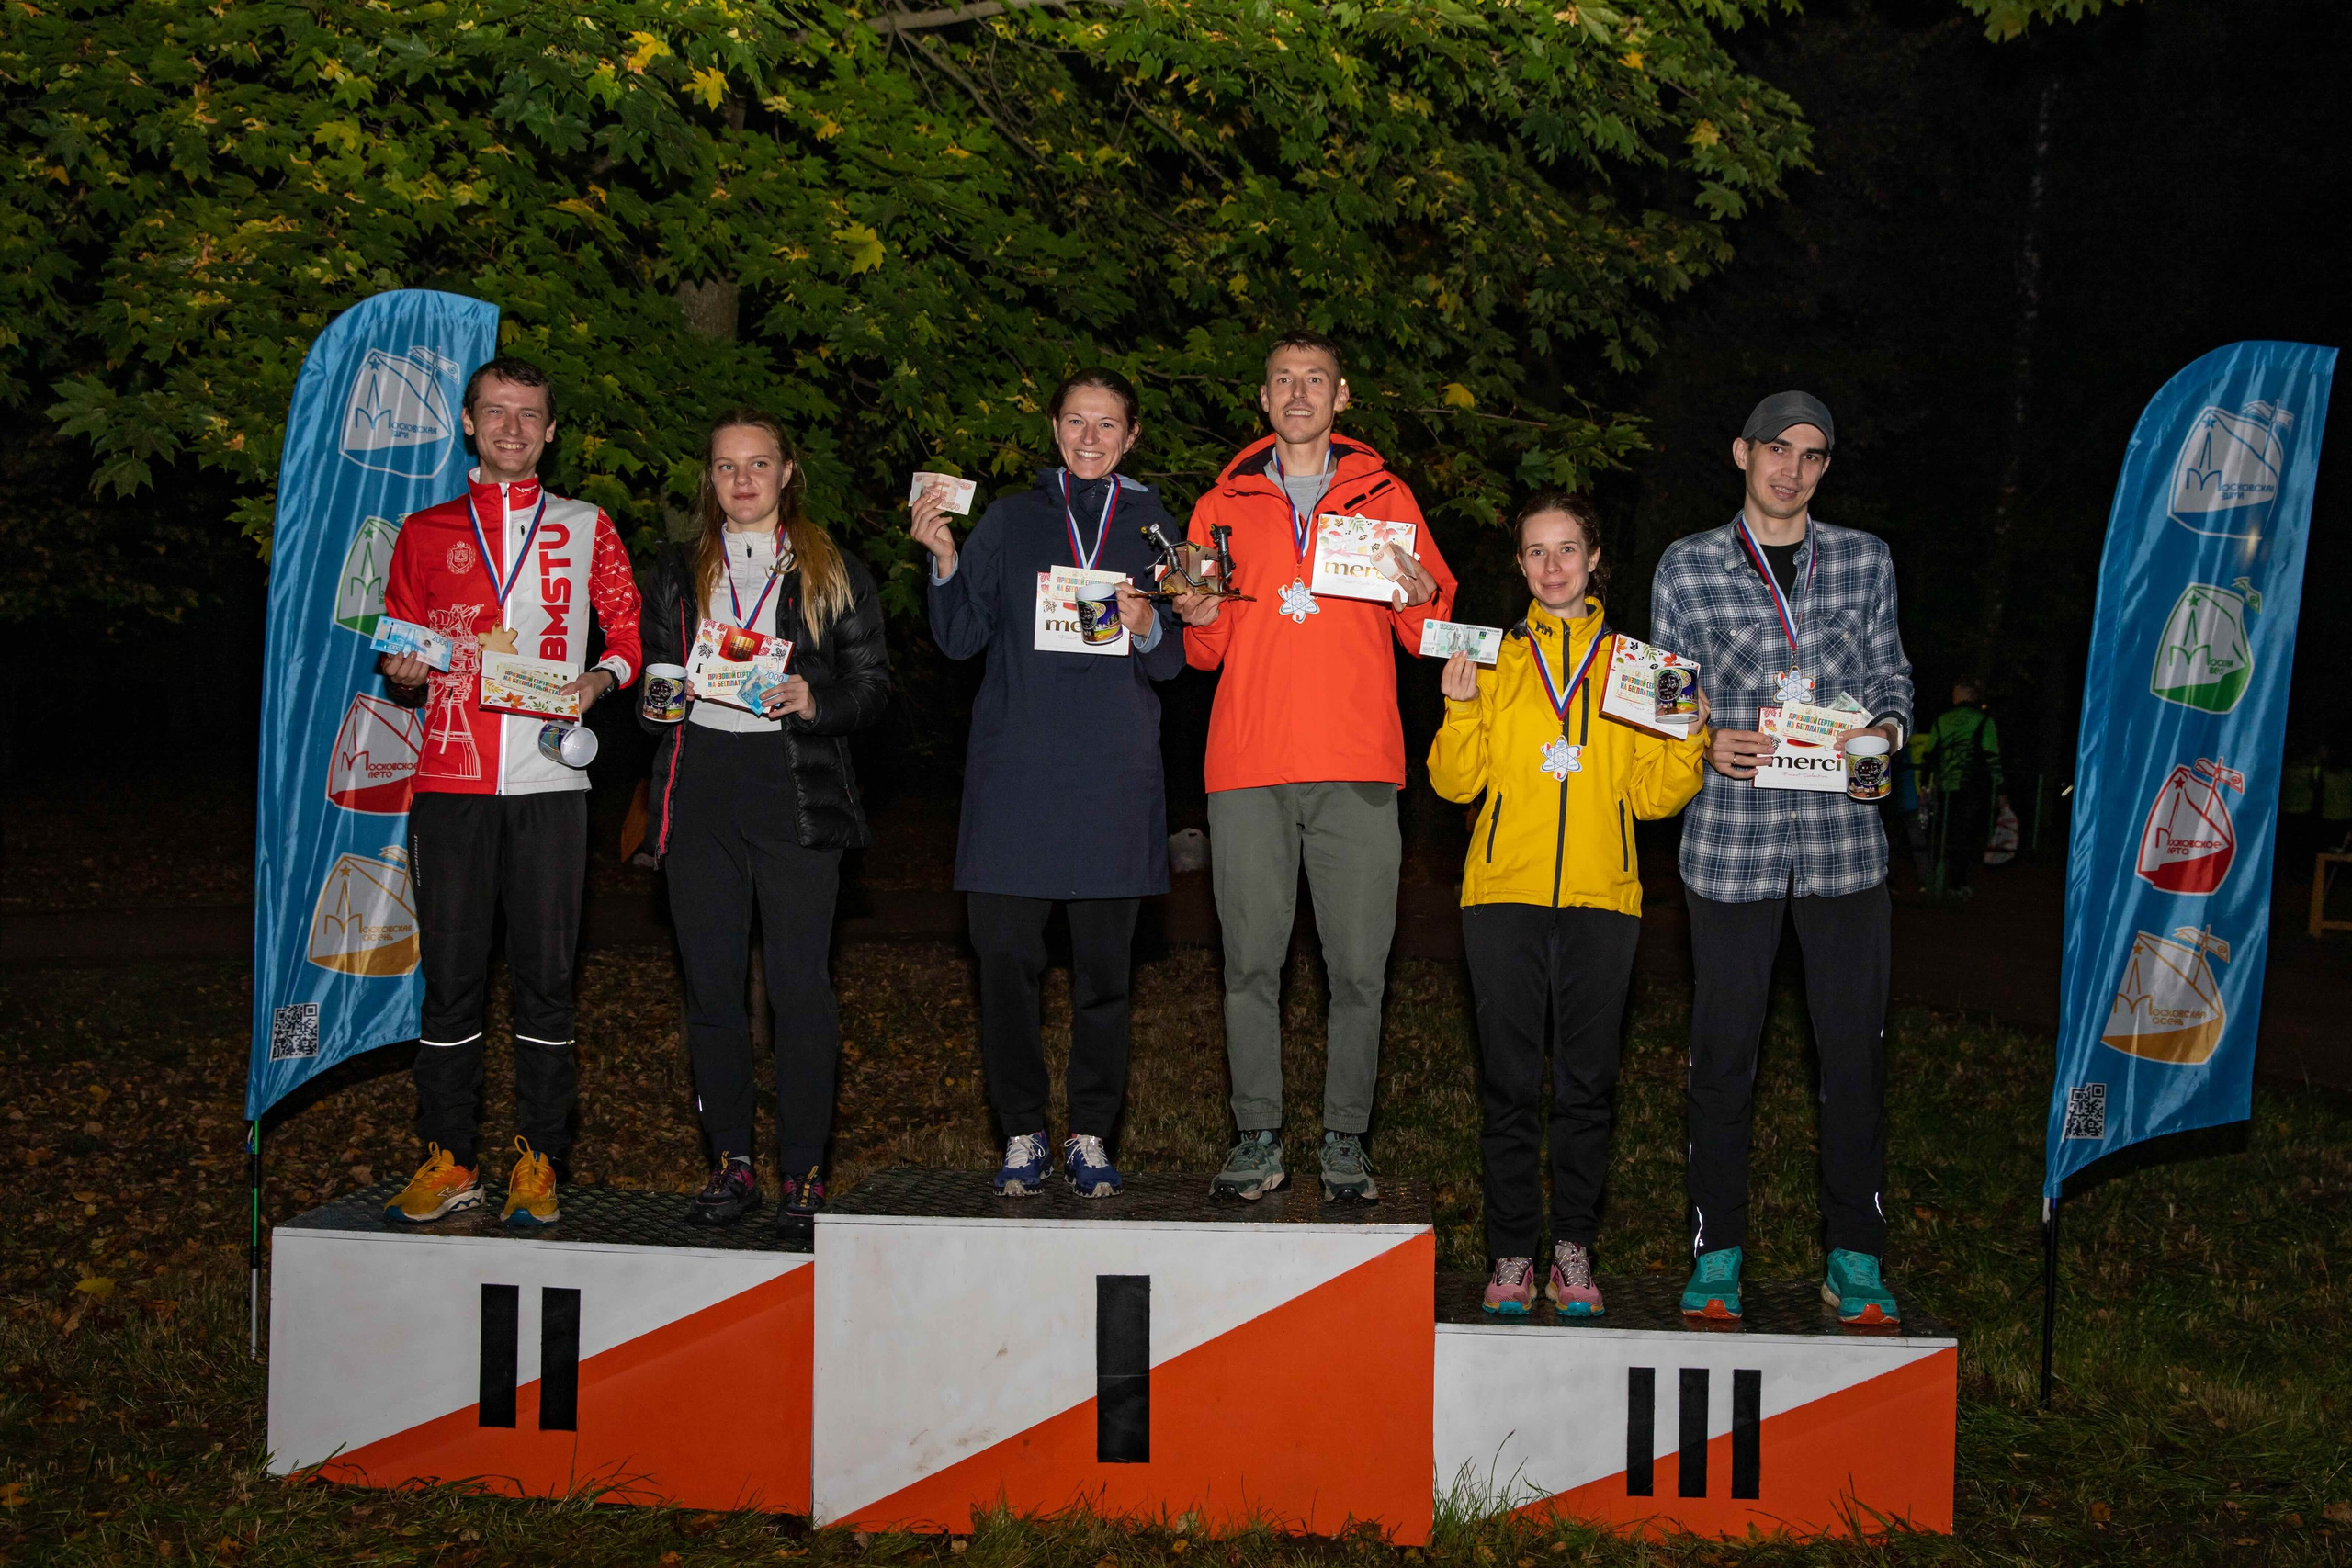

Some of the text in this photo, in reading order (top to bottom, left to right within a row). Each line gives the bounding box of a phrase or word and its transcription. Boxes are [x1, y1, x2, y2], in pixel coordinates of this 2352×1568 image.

[1324, 561, 1386, 580] mer
[538, 523, 571, 662] BMSTU
[533, 678, 561, 690] СЕРТИФИК
[708, 671, 736, 680] ПРИЗОВОЙ
[1627, 684, 1654, 698] БЕСПЛАТН
[1788, 712, 1817, 724] ПРИЗОВОЙ
[1786, 719, 1794, 728] НА
[1795, 722, 1833, 736] БЕСПЛАТНЫЙ
[1768, 753, 1842, 772] merci
[478, 1283, 581, 1431] II
[1626, 1366, 1762, 1500] III
